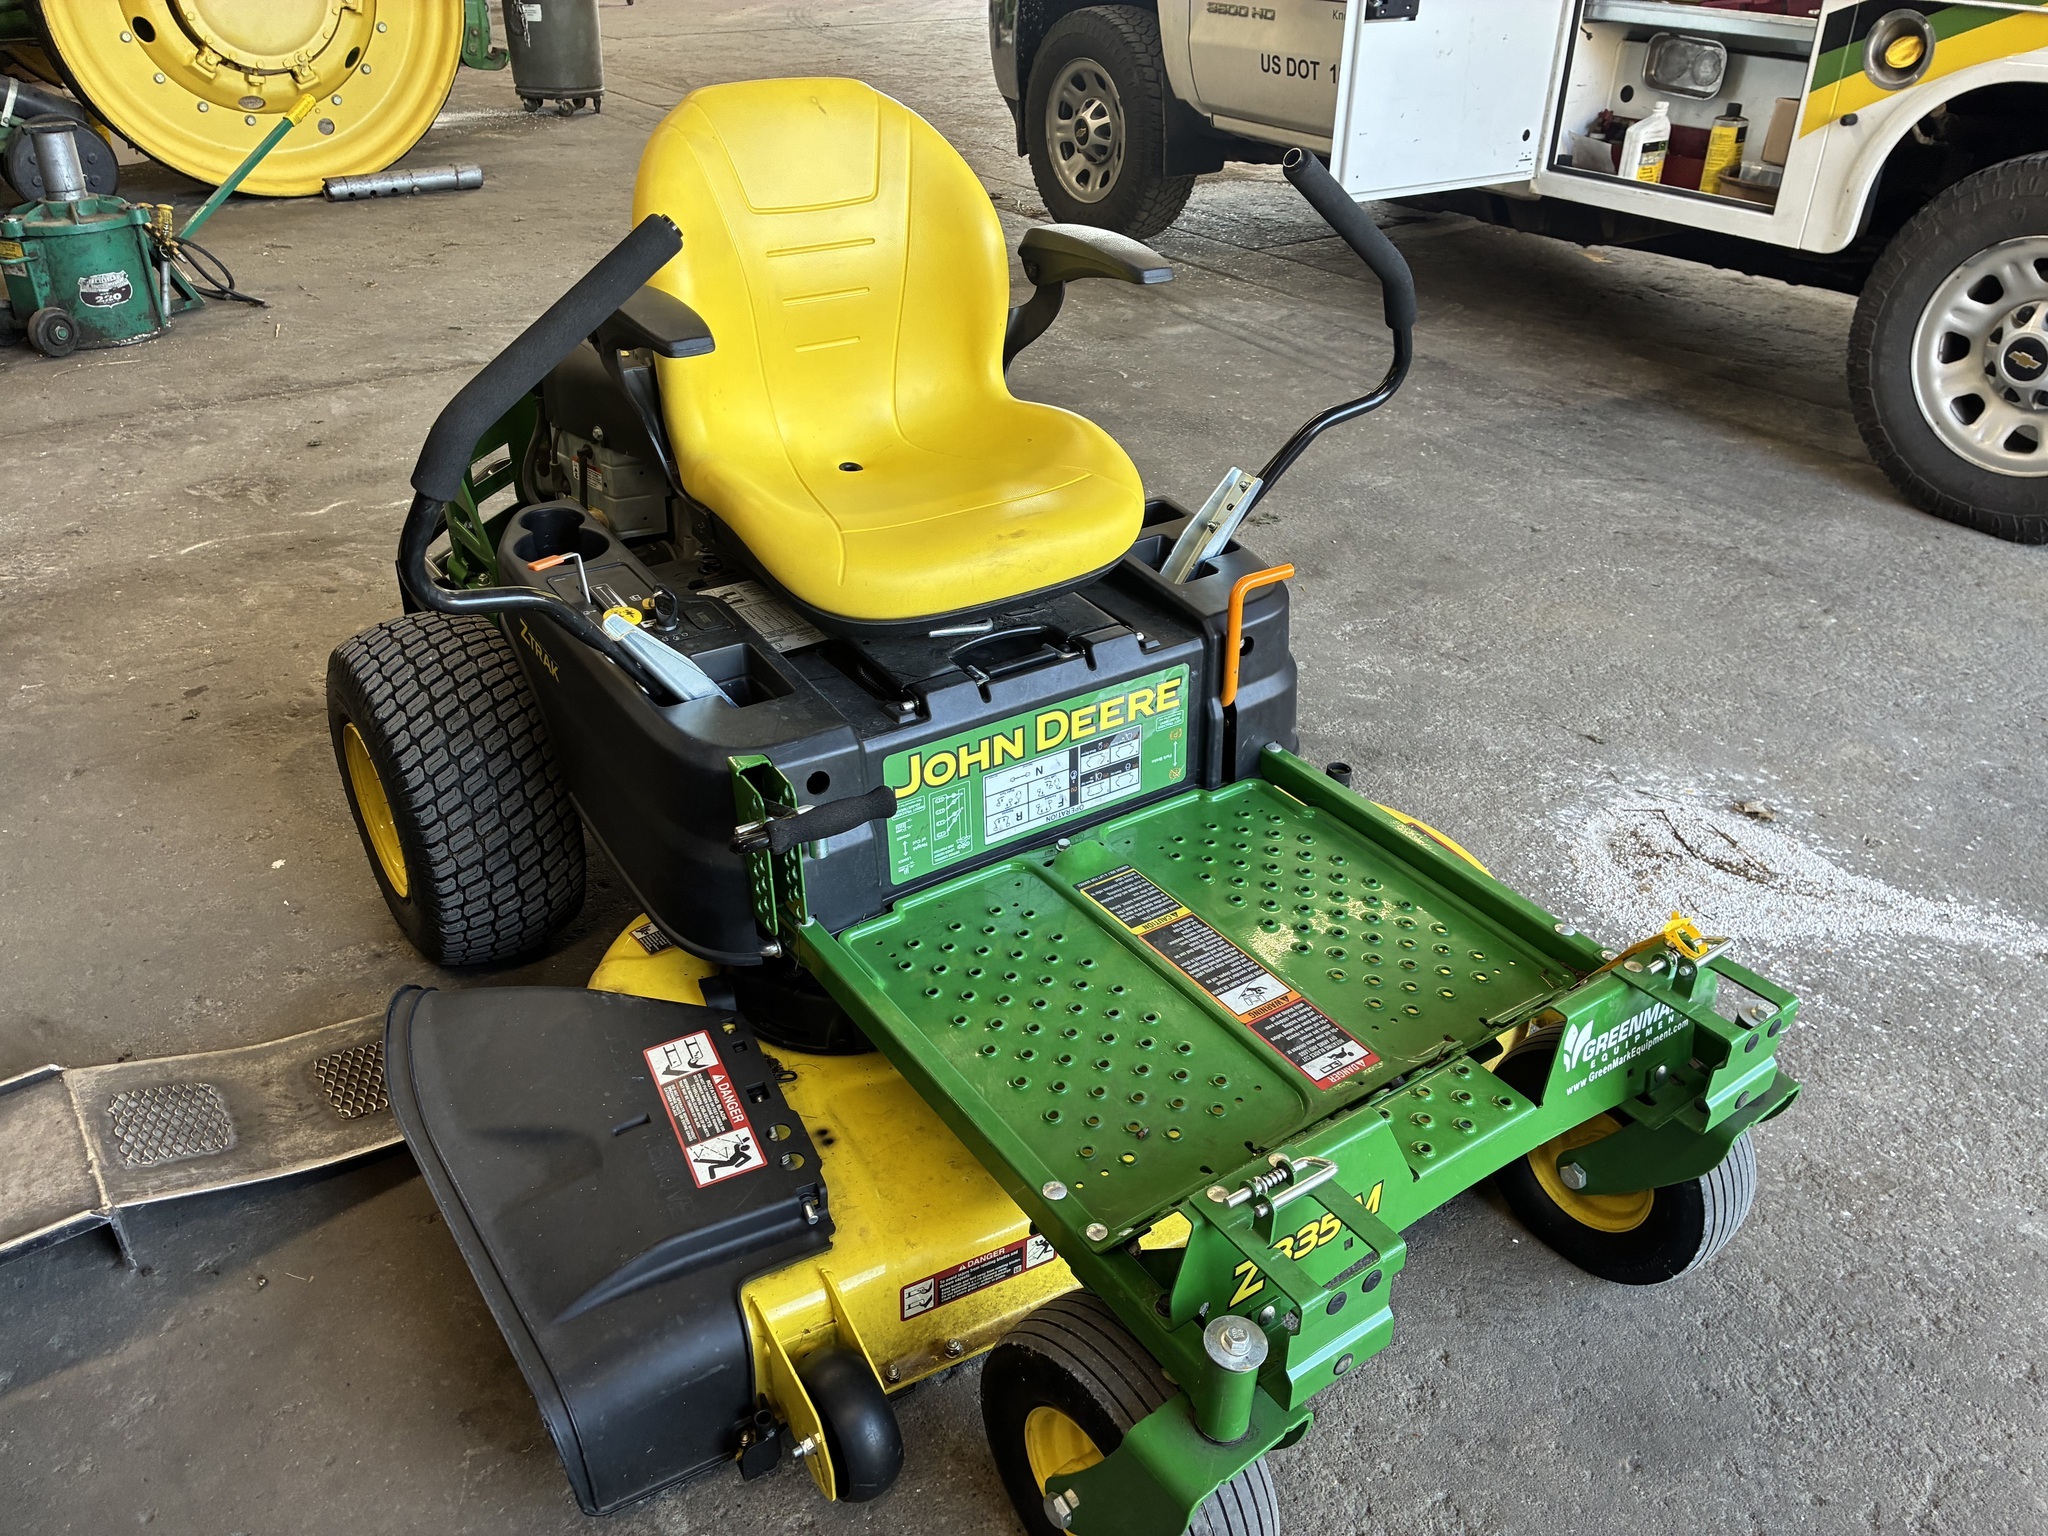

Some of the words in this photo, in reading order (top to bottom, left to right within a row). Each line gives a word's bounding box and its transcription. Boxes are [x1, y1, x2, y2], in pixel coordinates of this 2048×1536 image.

[1261, 53, 1281, 75] US
[1286, 57, 1320, 81] DOT
[95, 292, 122, 304] 220
[520, 617, 560, 683] ZTRAK
[894, 727, 1024, 799] JOHN
[1036, 677, 1181, 752] DEERE
[1035, 764, 1042, 776] N
[1045, 803, 1083, 822] OPERATION
[1057, 797, 1063, 807] F
[1015, 810, 1022, 821] R
[1140, 914, 1173, 929] CAUTION
[1246, 999, 1284, 1018] WARNING
[1582, 1001, 1675, 1063] GREENMA
[1590, 1014, 1682, 1069] EQUIPMEN
[1326, 1062, 1360, 1083] DANGER
[690, 1083, 703, 1105] THROWN
[699, 1105, 712, 1127] OBJECTS
[705, 1079, 720, 1104] ROTATING
[716, 1103, 727, 1121] BLADE
[717, 1082, 744, 1123] DANGER
[967, 1246, 1005, 1268] DANGER
